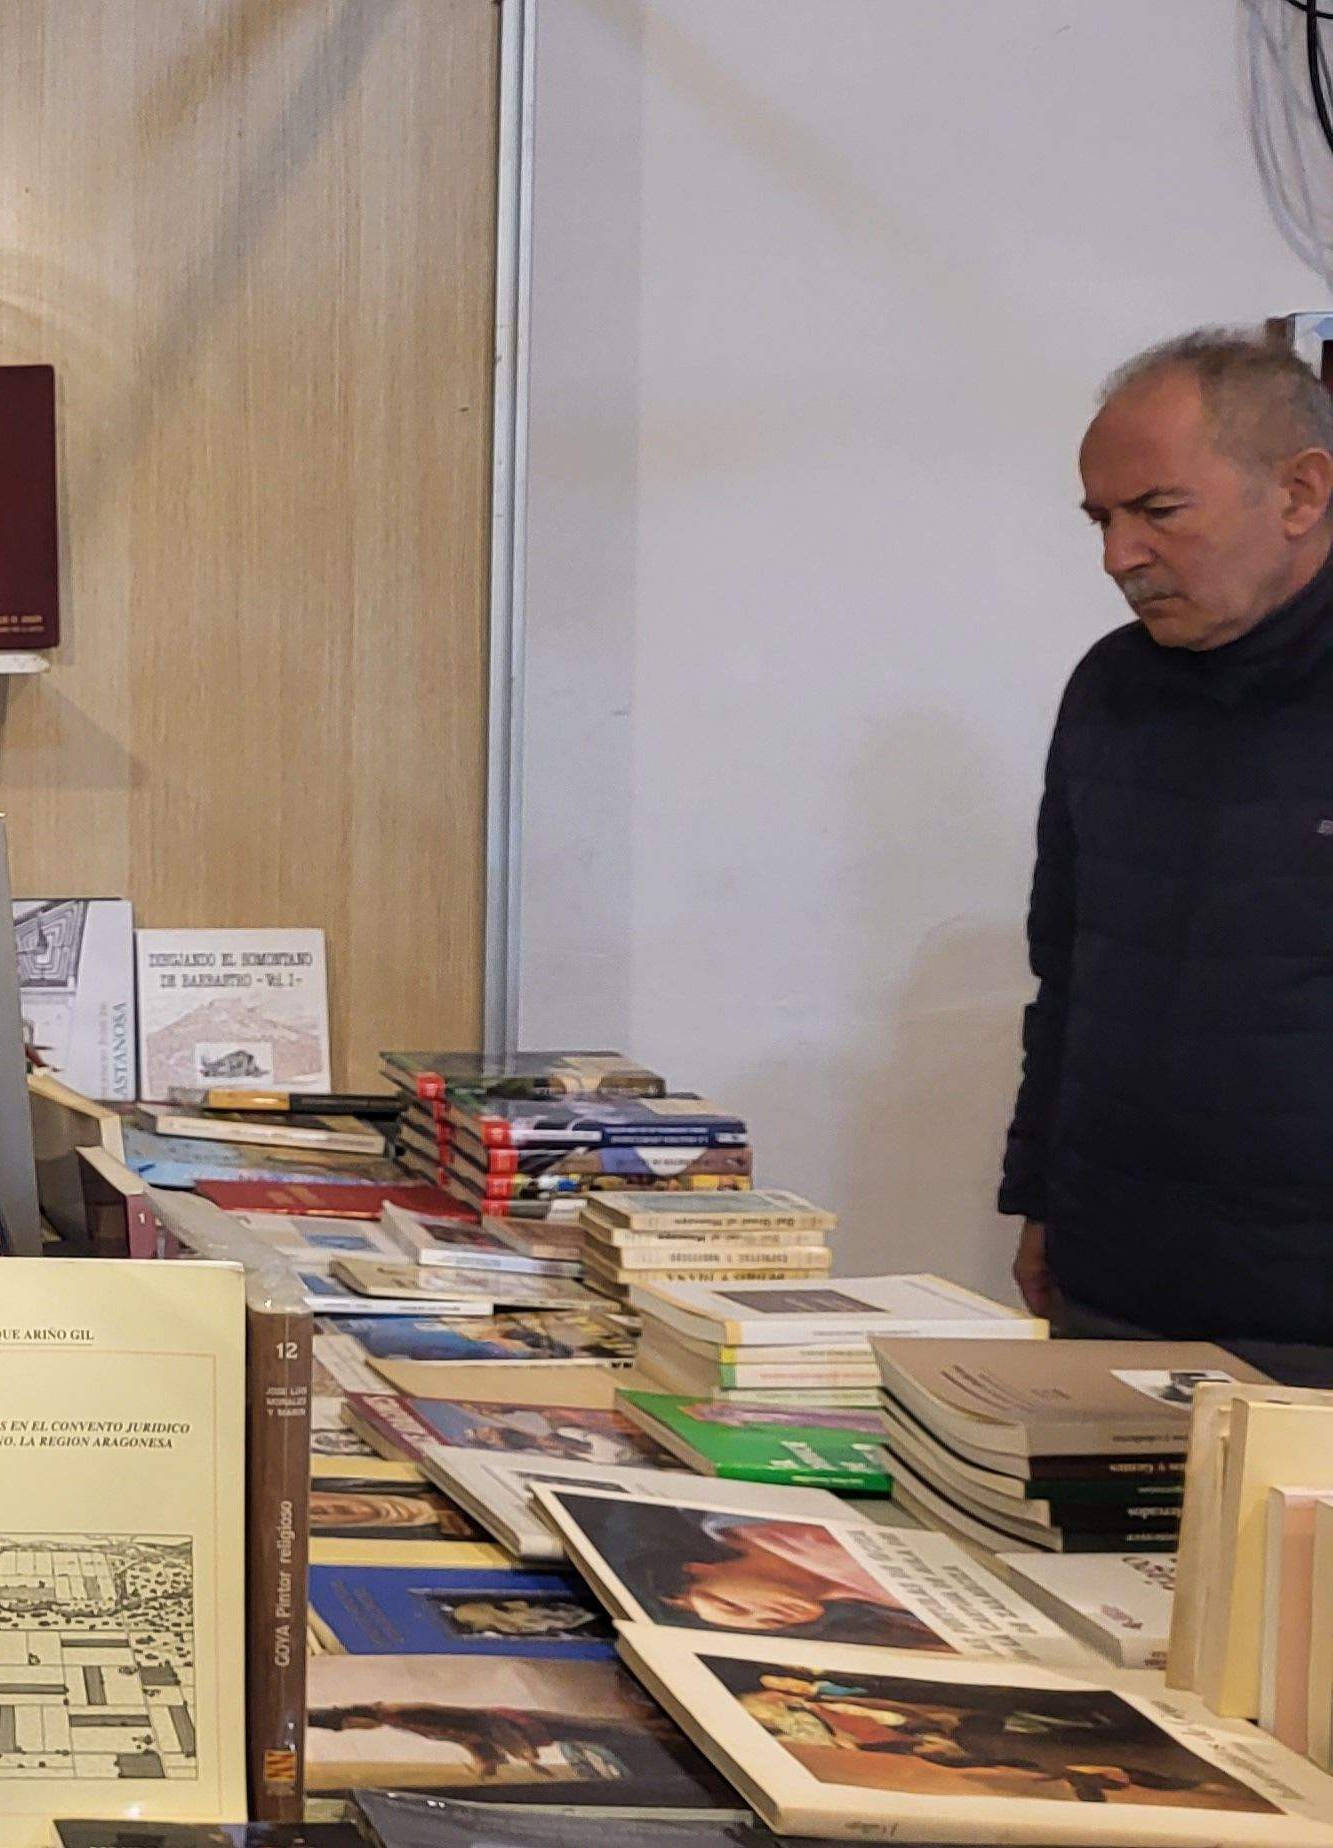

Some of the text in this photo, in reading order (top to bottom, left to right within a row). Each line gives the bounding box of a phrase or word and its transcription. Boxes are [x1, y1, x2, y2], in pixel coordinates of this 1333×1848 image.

[23, 1325, 67, 1342] ARIÑO
[69, 1328, 95, 1342] GIL
[275, 1342, 300, 1361] 12
[9, 1420, 28, 1432] EN
[31, 1420, 49, 1433] EL
[50, 1421, 123, 1433] CONVENTO
[125, 1422, 191, 1434] JURIDICO
[19, 1435, 36, 1447] LA
[38, 1435, 90, 1448] REGION
[92, 1436, 175, 1450] ARAGONESA
[274, 1500, 296, 1667] GOYA Pintor religioso
